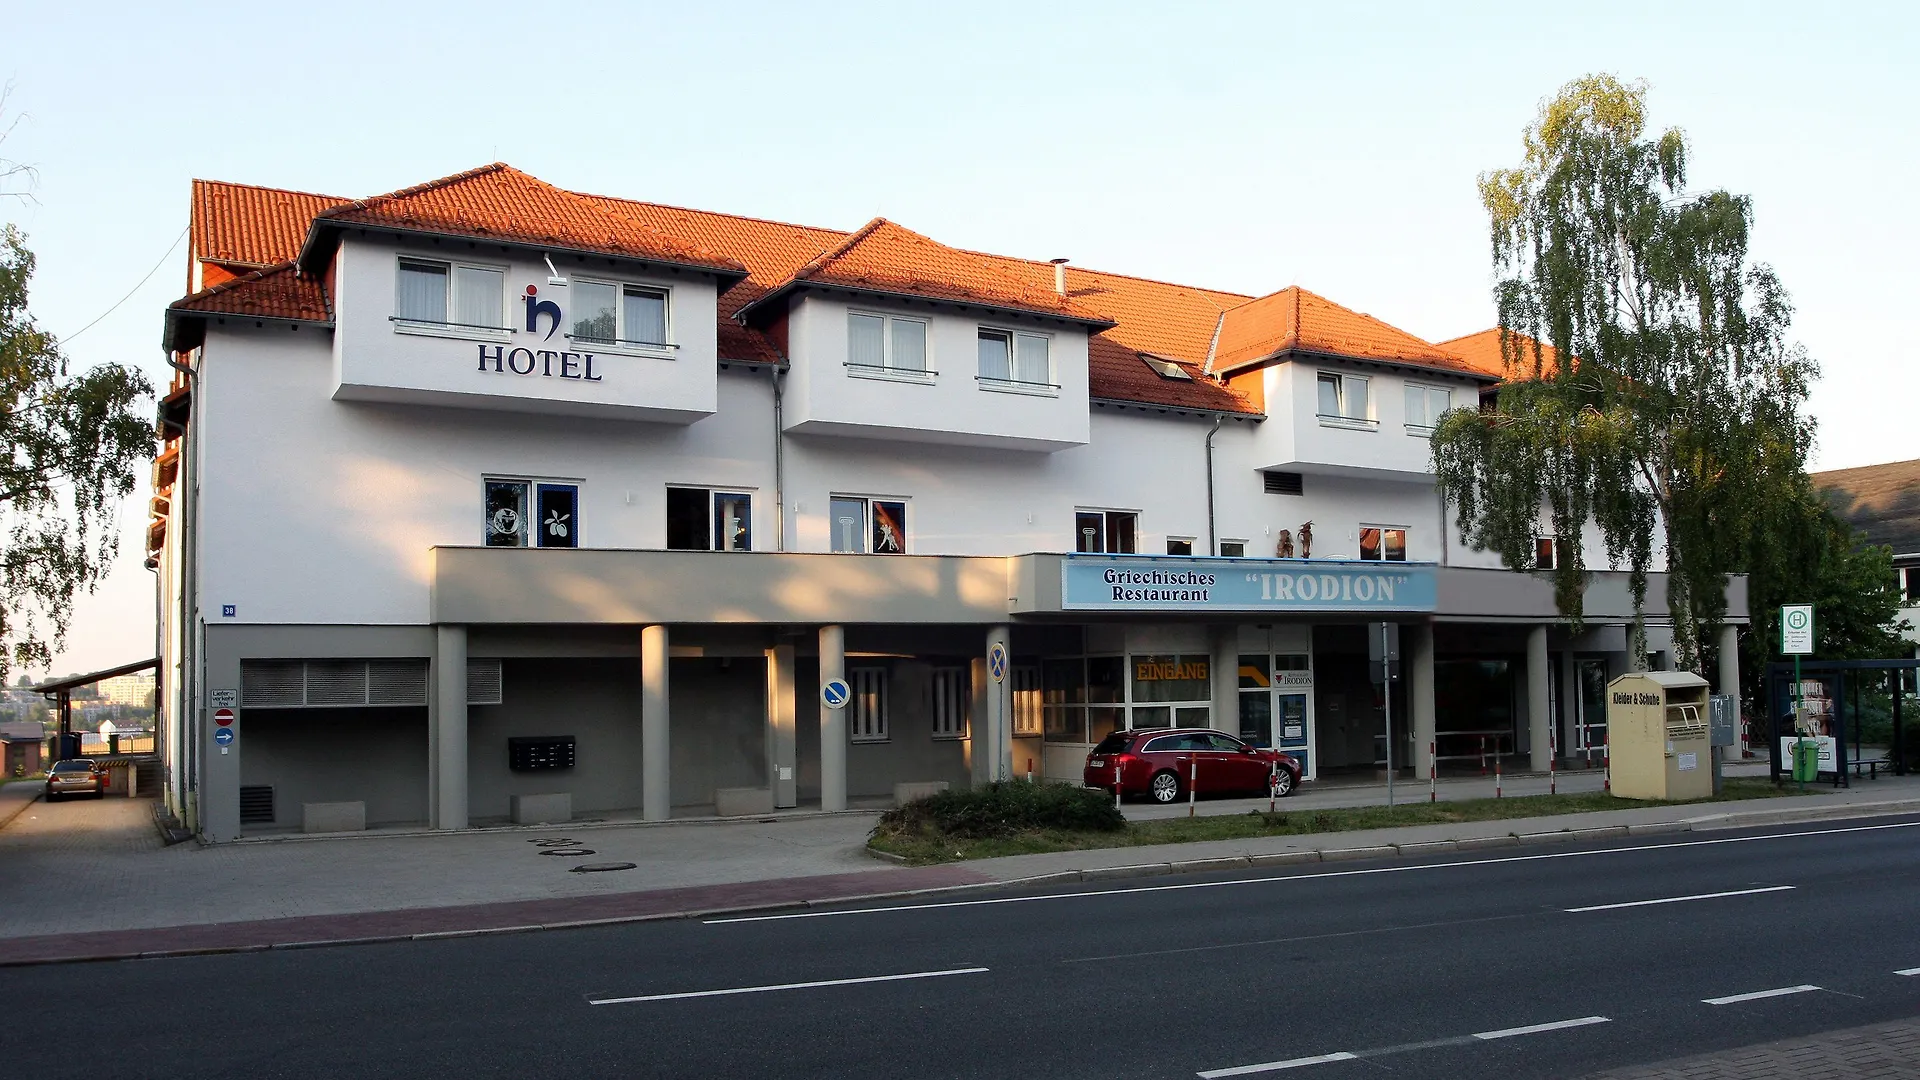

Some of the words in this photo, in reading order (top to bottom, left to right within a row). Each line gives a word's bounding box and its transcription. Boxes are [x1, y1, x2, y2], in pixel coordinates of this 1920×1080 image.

[477, 344, 603, 381] HOTEL
[1103, 568, 1215, 585] Griechisches
[1112, 586, 1210, 601] Restaurant
[224, 607, 234, 615] 38
[1793, 614, 1802, 626] H
[1136, 663, 1207, 680] EINGANG
[1613, 692, 1633, 705] Kleider
[1633, 692, 1638, 705] &
[1639, 692, 1660, 706] Schuhe
